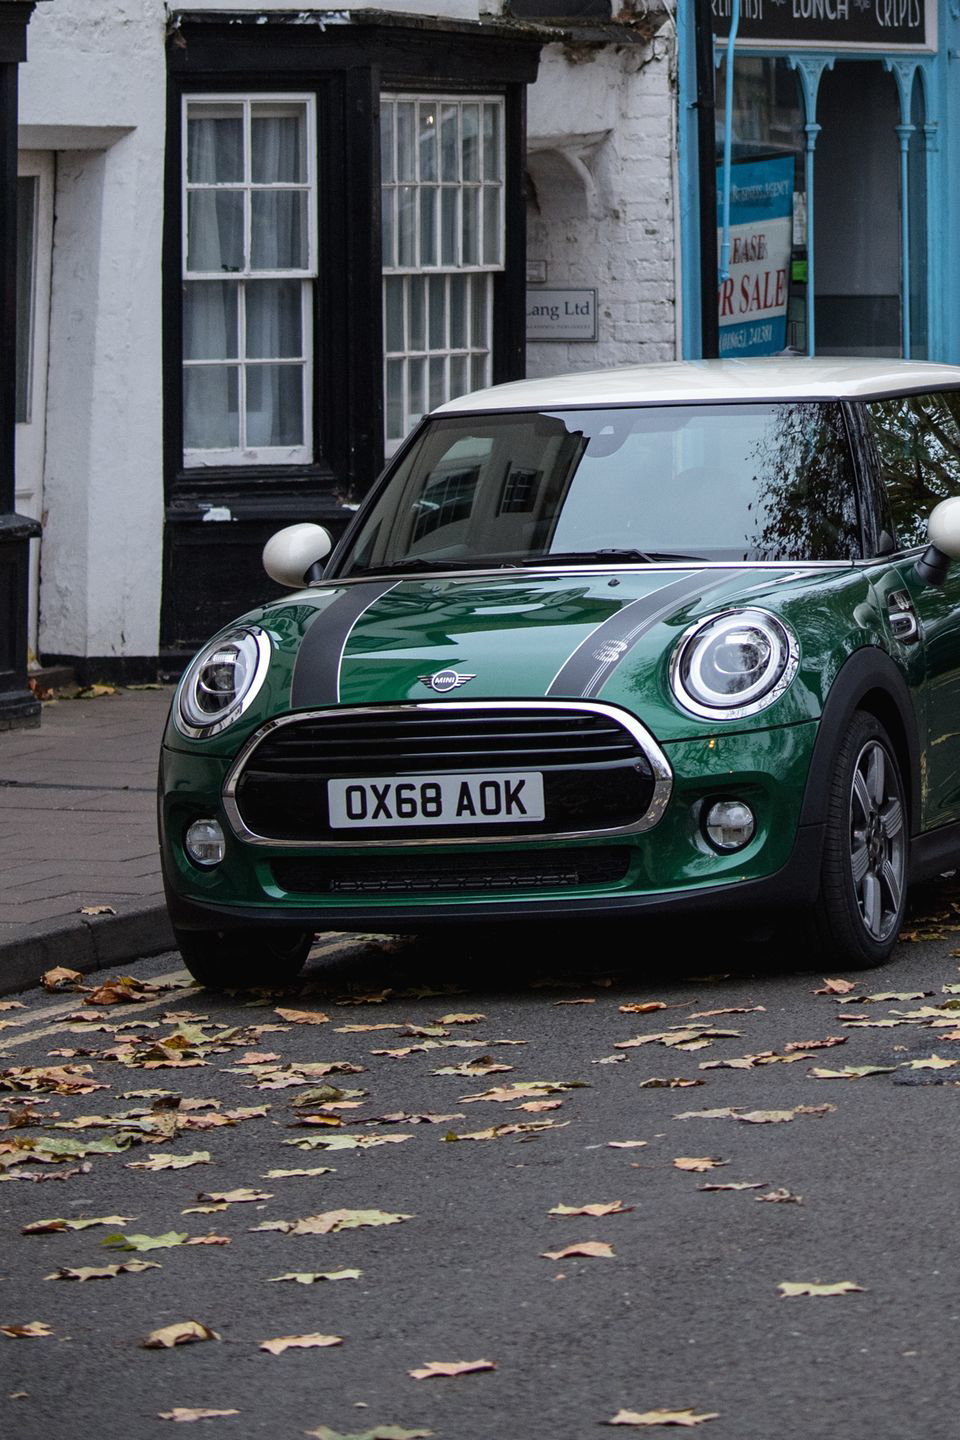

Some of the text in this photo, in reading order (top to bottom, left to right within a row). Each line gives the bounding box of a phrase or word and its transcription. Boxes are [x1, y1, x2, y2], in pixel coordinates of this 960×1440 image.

[729, 234, 766, 265] EASE
[740, 269, 786, 314] SALE
[564, 301, 590, 316] Ltd
[435, 676, 455, 684] MINI
[345, 779, 528, 820] OX68 AOK
